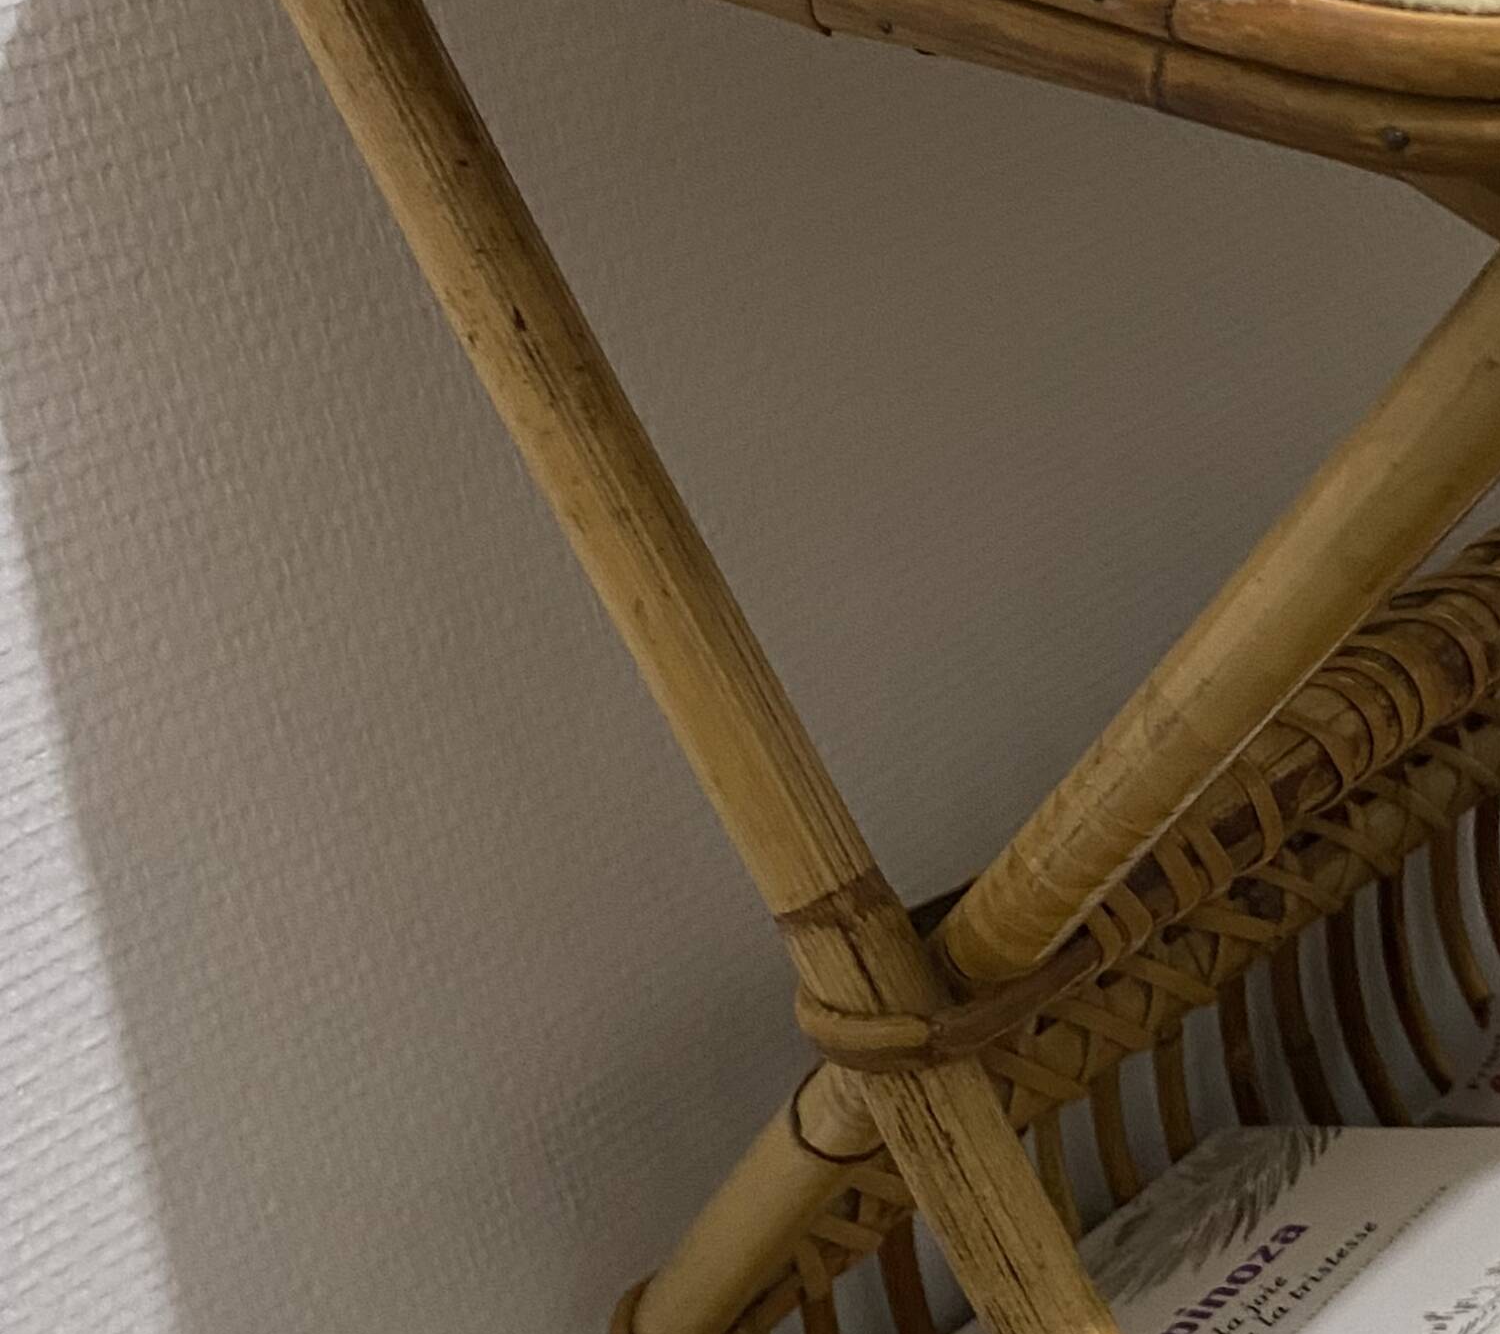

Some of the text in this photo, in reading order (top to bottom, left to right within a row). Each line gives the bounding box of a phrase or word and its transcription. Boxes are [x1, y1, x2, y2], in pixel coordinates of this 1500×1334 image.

[1243, 1276, 1288, 1315] joie
[1258, 1306, 1289, 1328] la
[1289, 1221, 1378, 1301] tristesse
